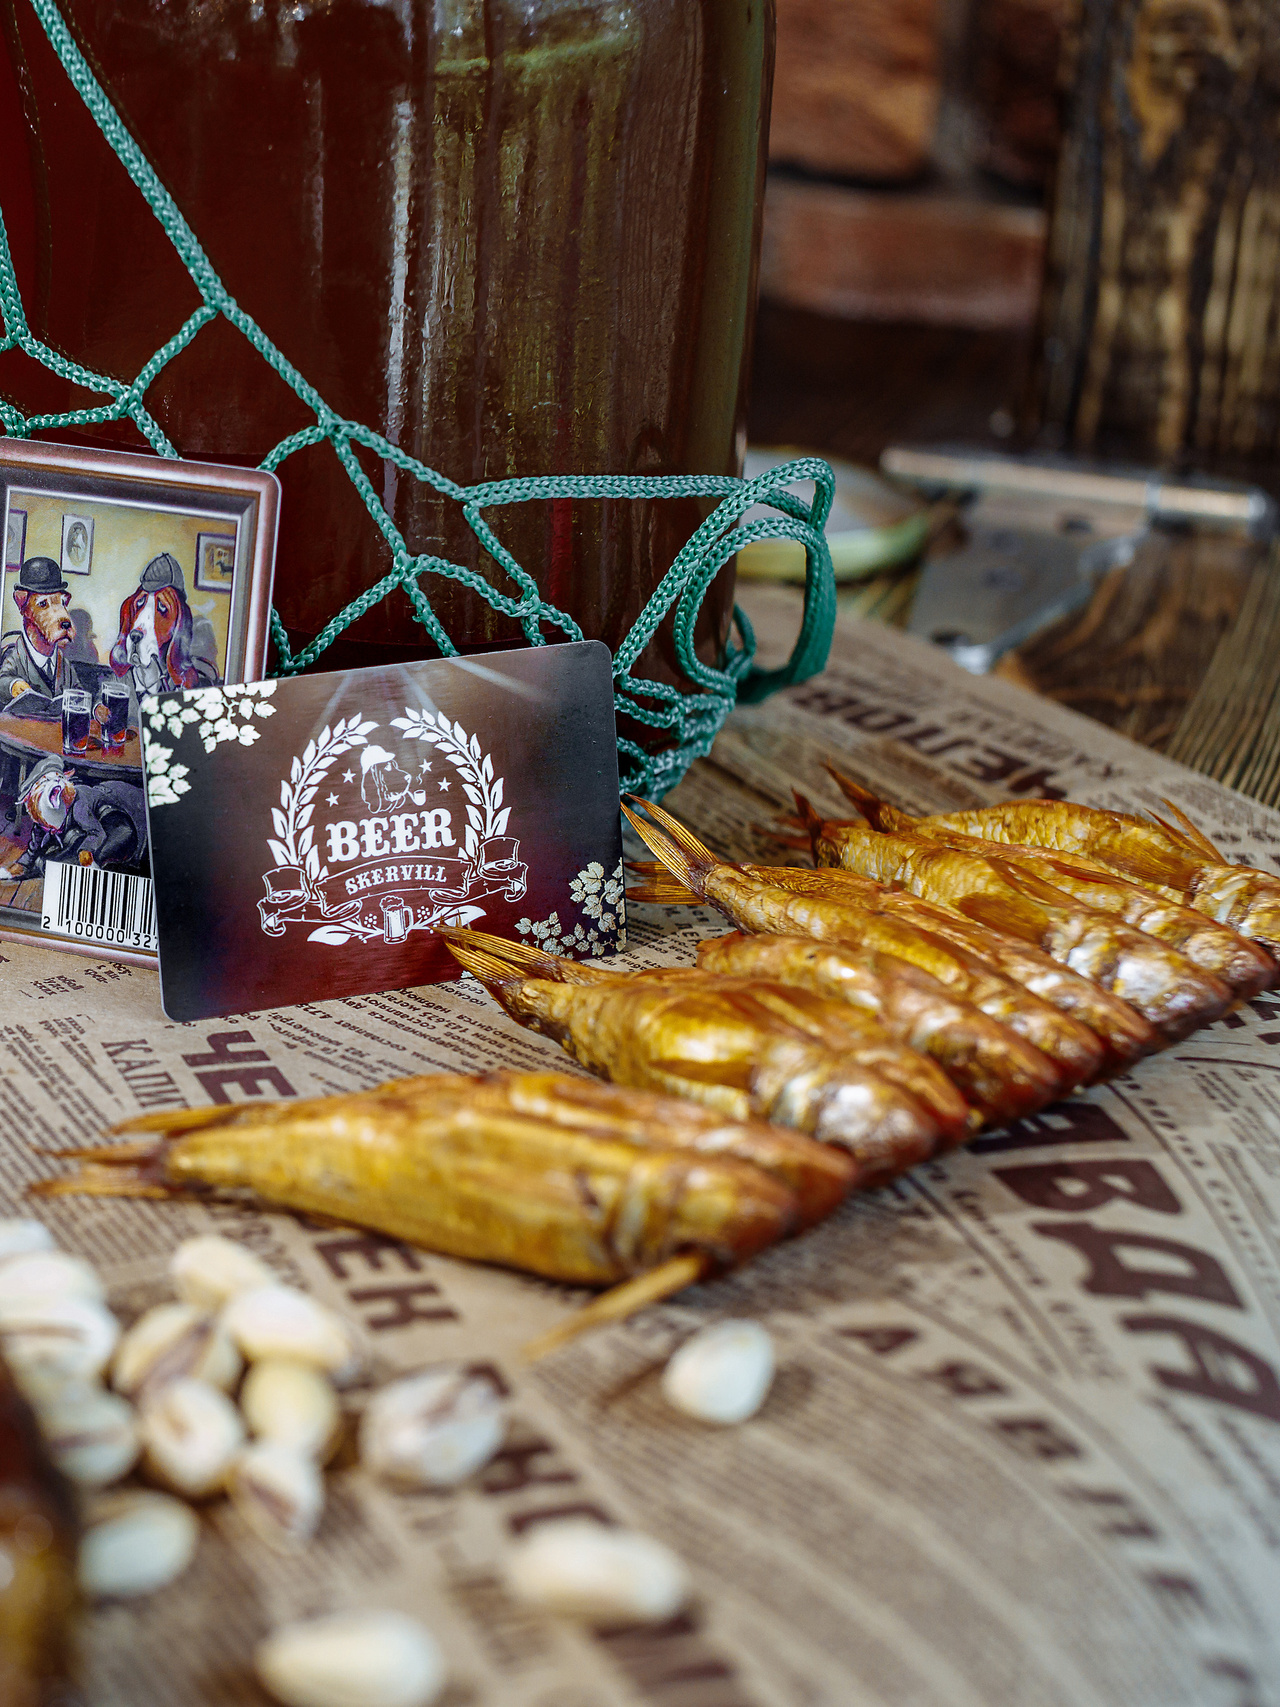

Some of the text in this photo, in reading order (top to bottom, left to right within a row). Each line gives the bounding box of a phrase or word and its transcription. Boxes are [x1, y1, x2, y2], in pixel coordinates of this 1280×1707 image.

[325, 808, 457, 863] BEER
[344, 863, 447, 896] SKERVILL
[64, 920, 124, 943] 100000
[359, 993, 437, 1032] составляют
[456, 1012, 551, 1058] производится
